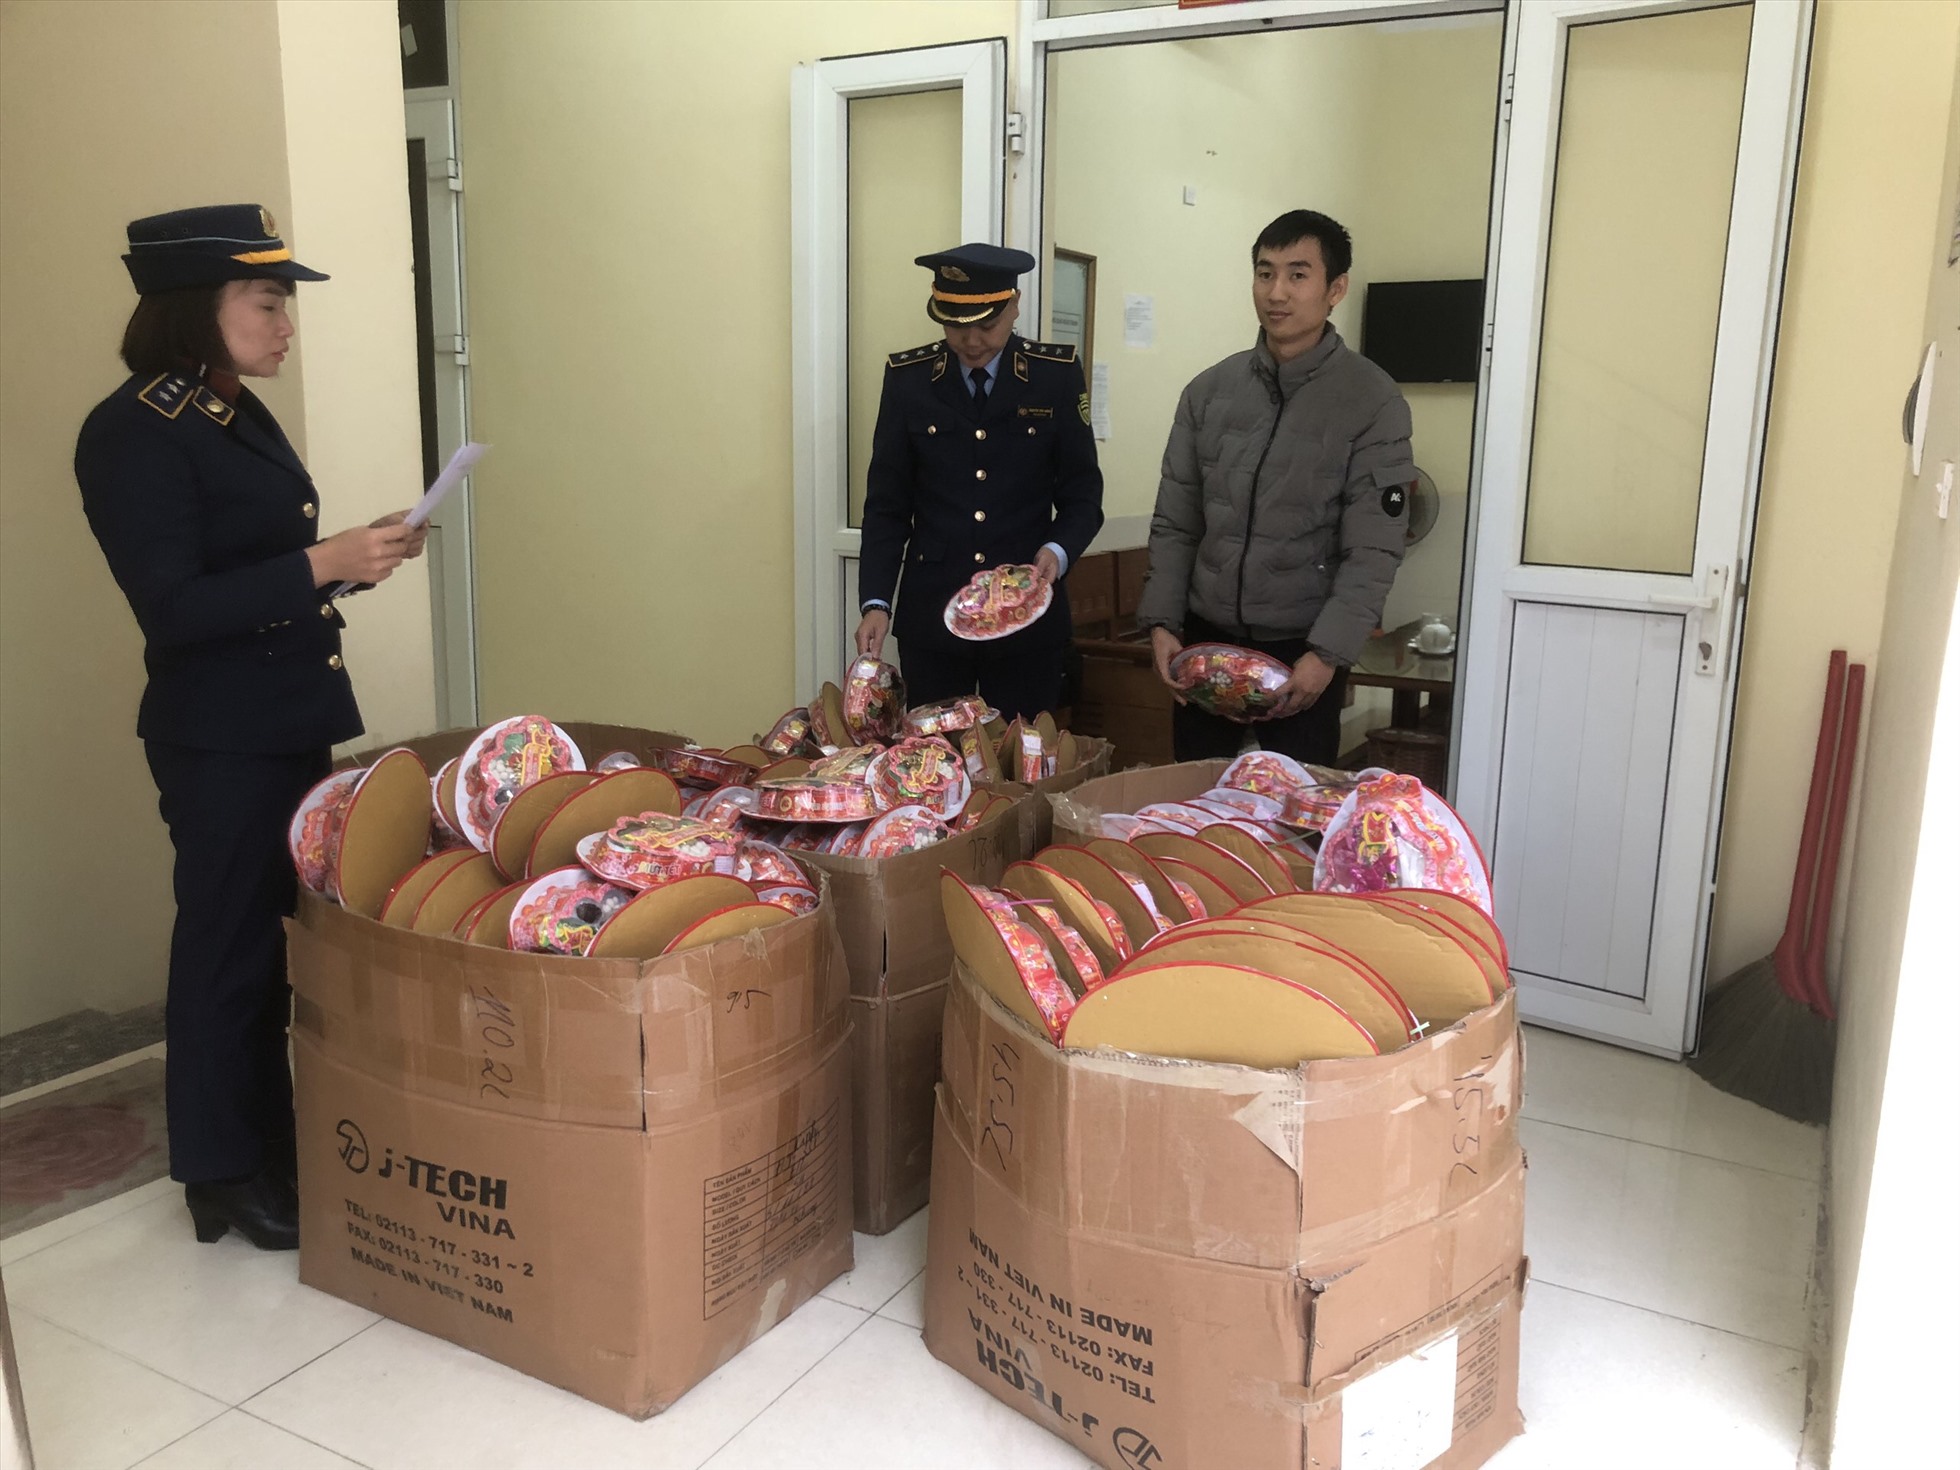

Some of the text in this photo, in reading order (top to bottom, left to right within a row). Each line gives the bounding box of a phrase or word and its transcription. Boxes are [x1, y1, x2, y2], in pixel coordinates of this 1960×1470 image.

[344, 1198, 372, 1223] TEL:
[375, 1213, 417, 1242] 02113
[428, 1235, 457, 1256] 717
[471, 1249, 500, 1270] 331
[436, 1201, 516, 1240] VINA
[347, 1221, 376, 1247] FAX:
[379, 1237, 421, 1264] 02113
[432, 1258, 460, 1279] 717
[474, 1273, 504, 1294] 330
[973, 1261, 996, 1290] 330
[351, 1247, 513, 1324] MADE IN VIET NAM
[969, 1227, 1153, 1346] MADE IN VIET NAM
[976, 1285, 999, 1315] 331
[1007, 1291, 1034, 1320] 717
[967, 1307, 1033, 1372] VINA
[1011, 1316, 1038, 1344] 717
[1046, 1319, 1101, 1356] 02113
[1050, 1343, 1103, 1382] 02113
[1107, 1345, 1154, 1377] FAX:
[1109, 1372, 1156, 1405] TEL:
